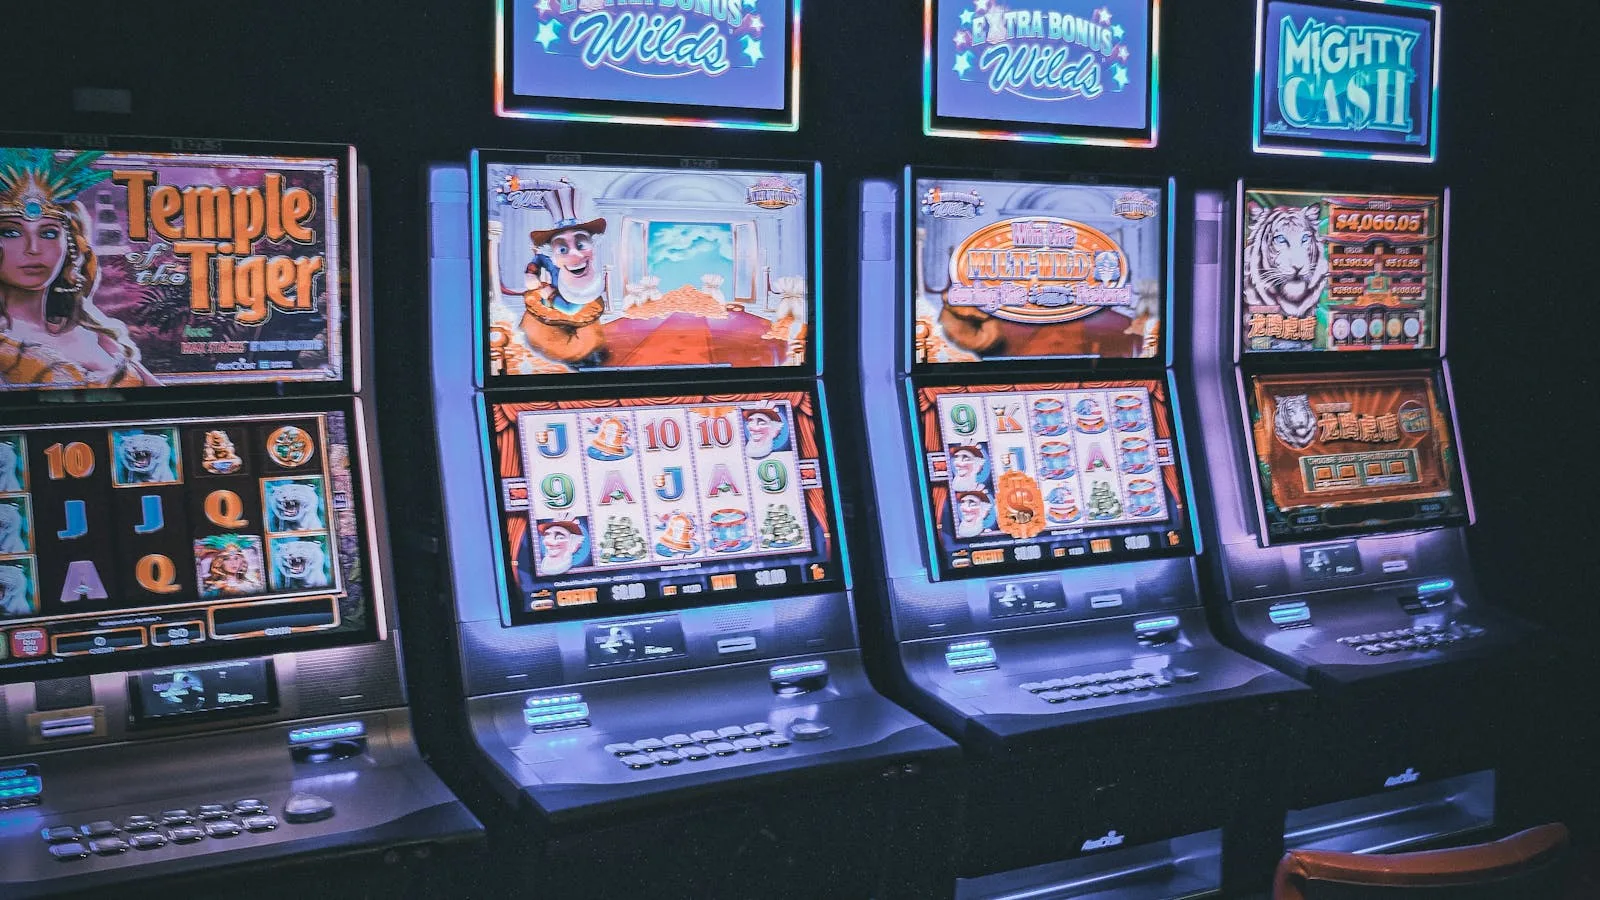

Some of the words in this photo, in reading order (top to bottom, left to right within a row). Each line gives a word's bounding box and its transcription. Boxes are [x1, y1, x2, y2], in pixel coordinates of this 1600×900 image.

[570, 12, 730, 75] Wilds
[972, 10, 1043, 46] EXTRA
[1047, 12, 1113, 56] BONUS
[1282, 18, 1418, 75] MIGHTY
[980, 44, 1103, 98] Wilds
[112, 169, 318, 255] Temple
[1336, 213, 1421, 232] $4,066.05
[125, 242, 170, 270] of
[136, 263, 188, 286] the
[173, 242, 326, 327] Tiger
[644, 417, 683, 452] 10
[697, 416, 735, 449] 10
[950, 403, 978, 436] 9
[993, 403, 1024, 434] K
[44, 440, 96, 481] 10
[1086, 441, 1112, 473] A
[541, 473, 575, 510] 9
[599, 469, 636, 506] A
[708, 463, 741, 498] A
[757, 459, 789, 494] 9
[57, 500, 88, 540] J
[134, 495, 164, 534] J
[203, 489, 250, 529] Q
[59, 560, 109, 603] A
[135, 554, 182, 594] Q
